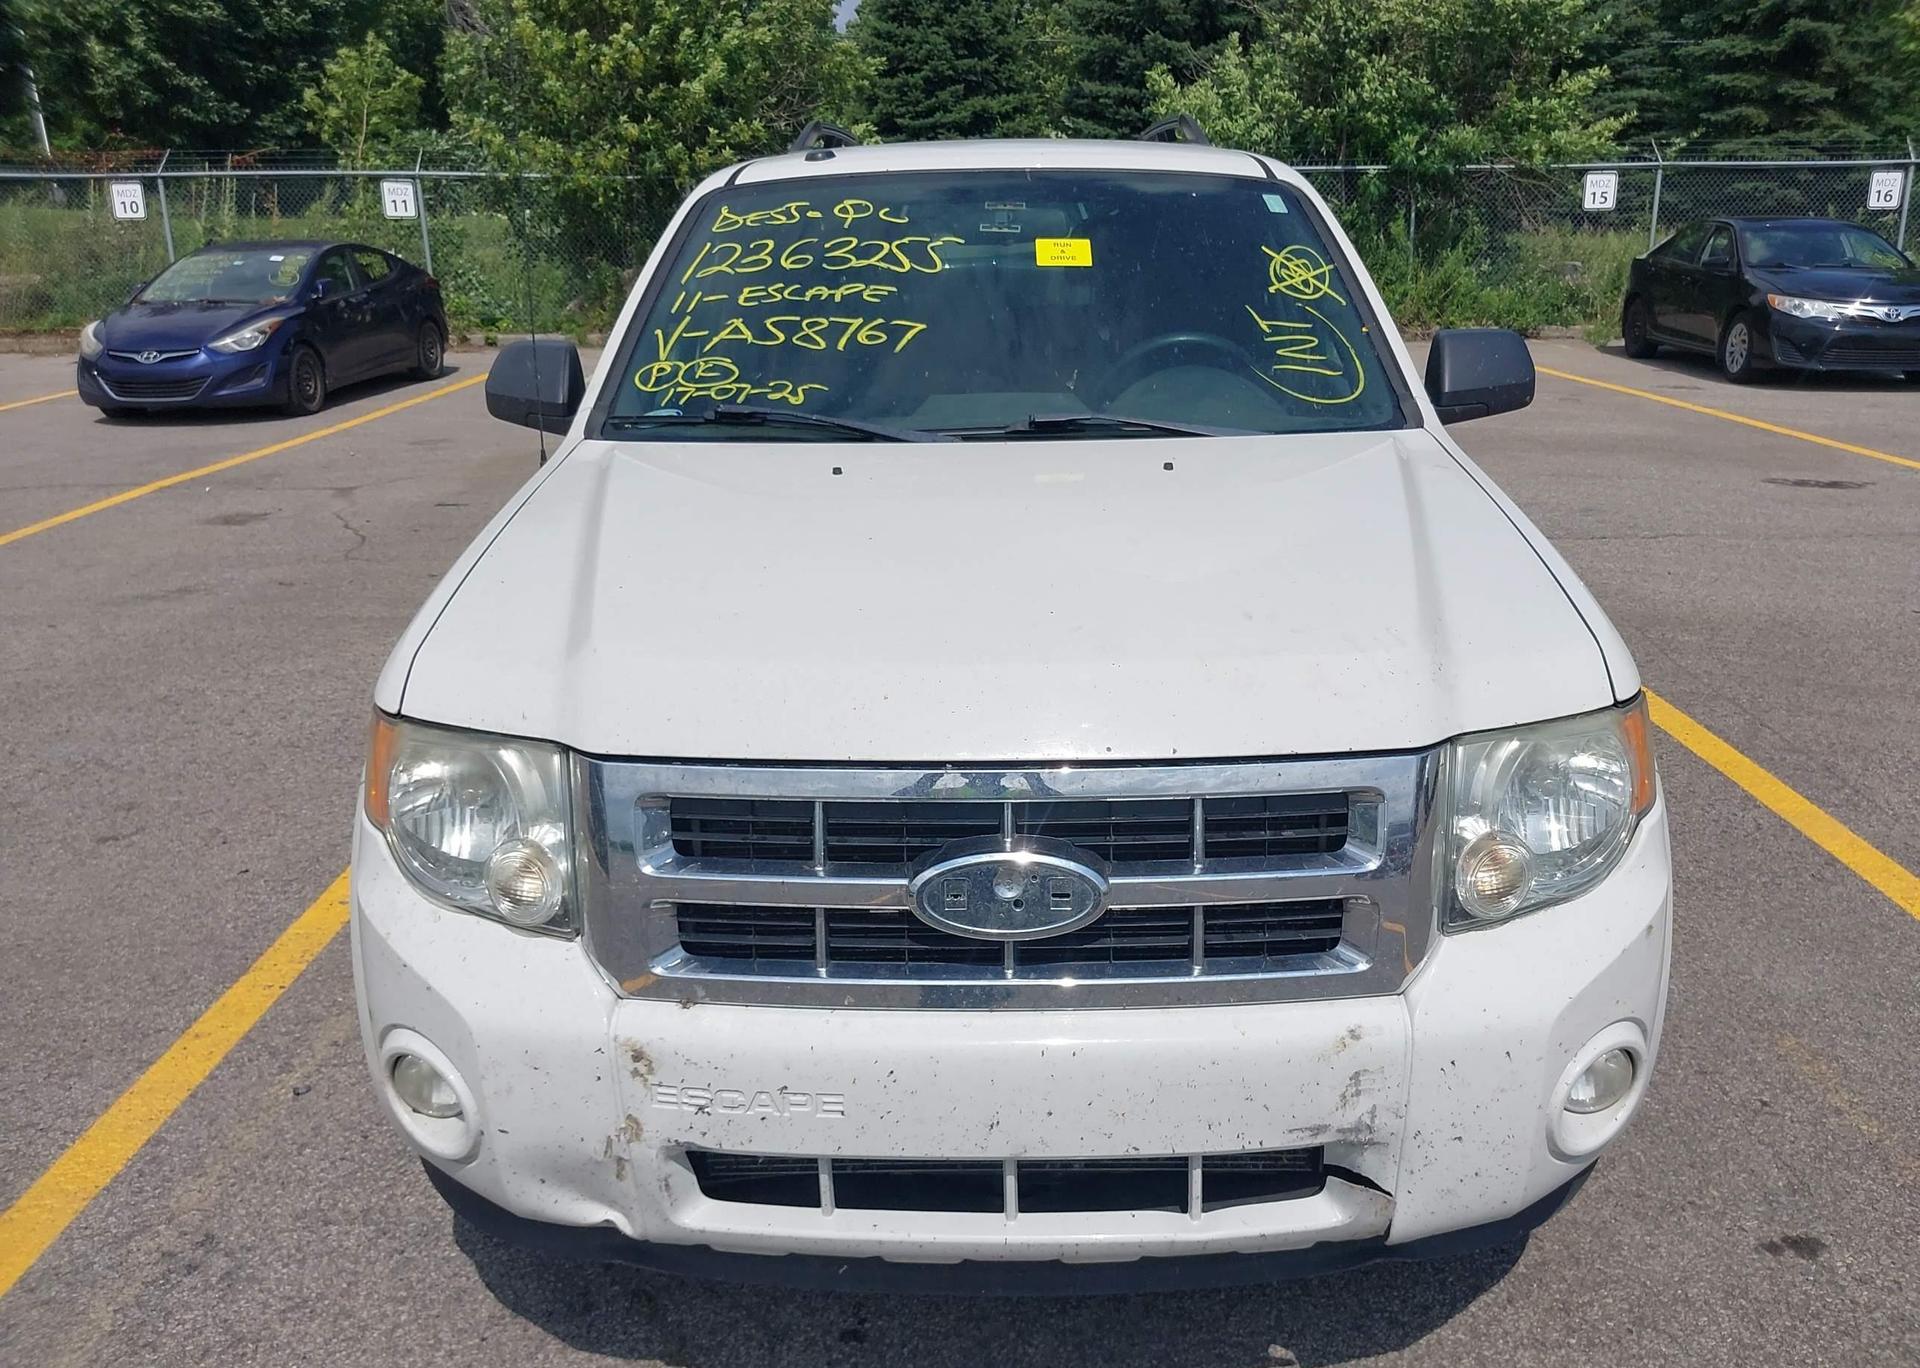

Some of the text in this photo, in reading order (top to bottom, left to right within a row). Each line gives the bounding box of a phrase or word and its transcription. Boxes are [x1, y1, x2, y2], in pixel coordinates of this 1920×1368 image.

[1589, 179, 1611, 189] MDZ
[1875, 178, 1897, 188] MDZ
[117, 189, 138, 199] MDZ
[387, 187, 409, 197] MDZ
[1590, 191, 1608, 205] 15
[1875, 189, 1893, 203] 16
[120, 200, 139, 214] 10
[391, 199, 408, 213] 11
[681, 237, 966, 285] 12363255
[651, 1083, 846, 1118] ESCAPE
